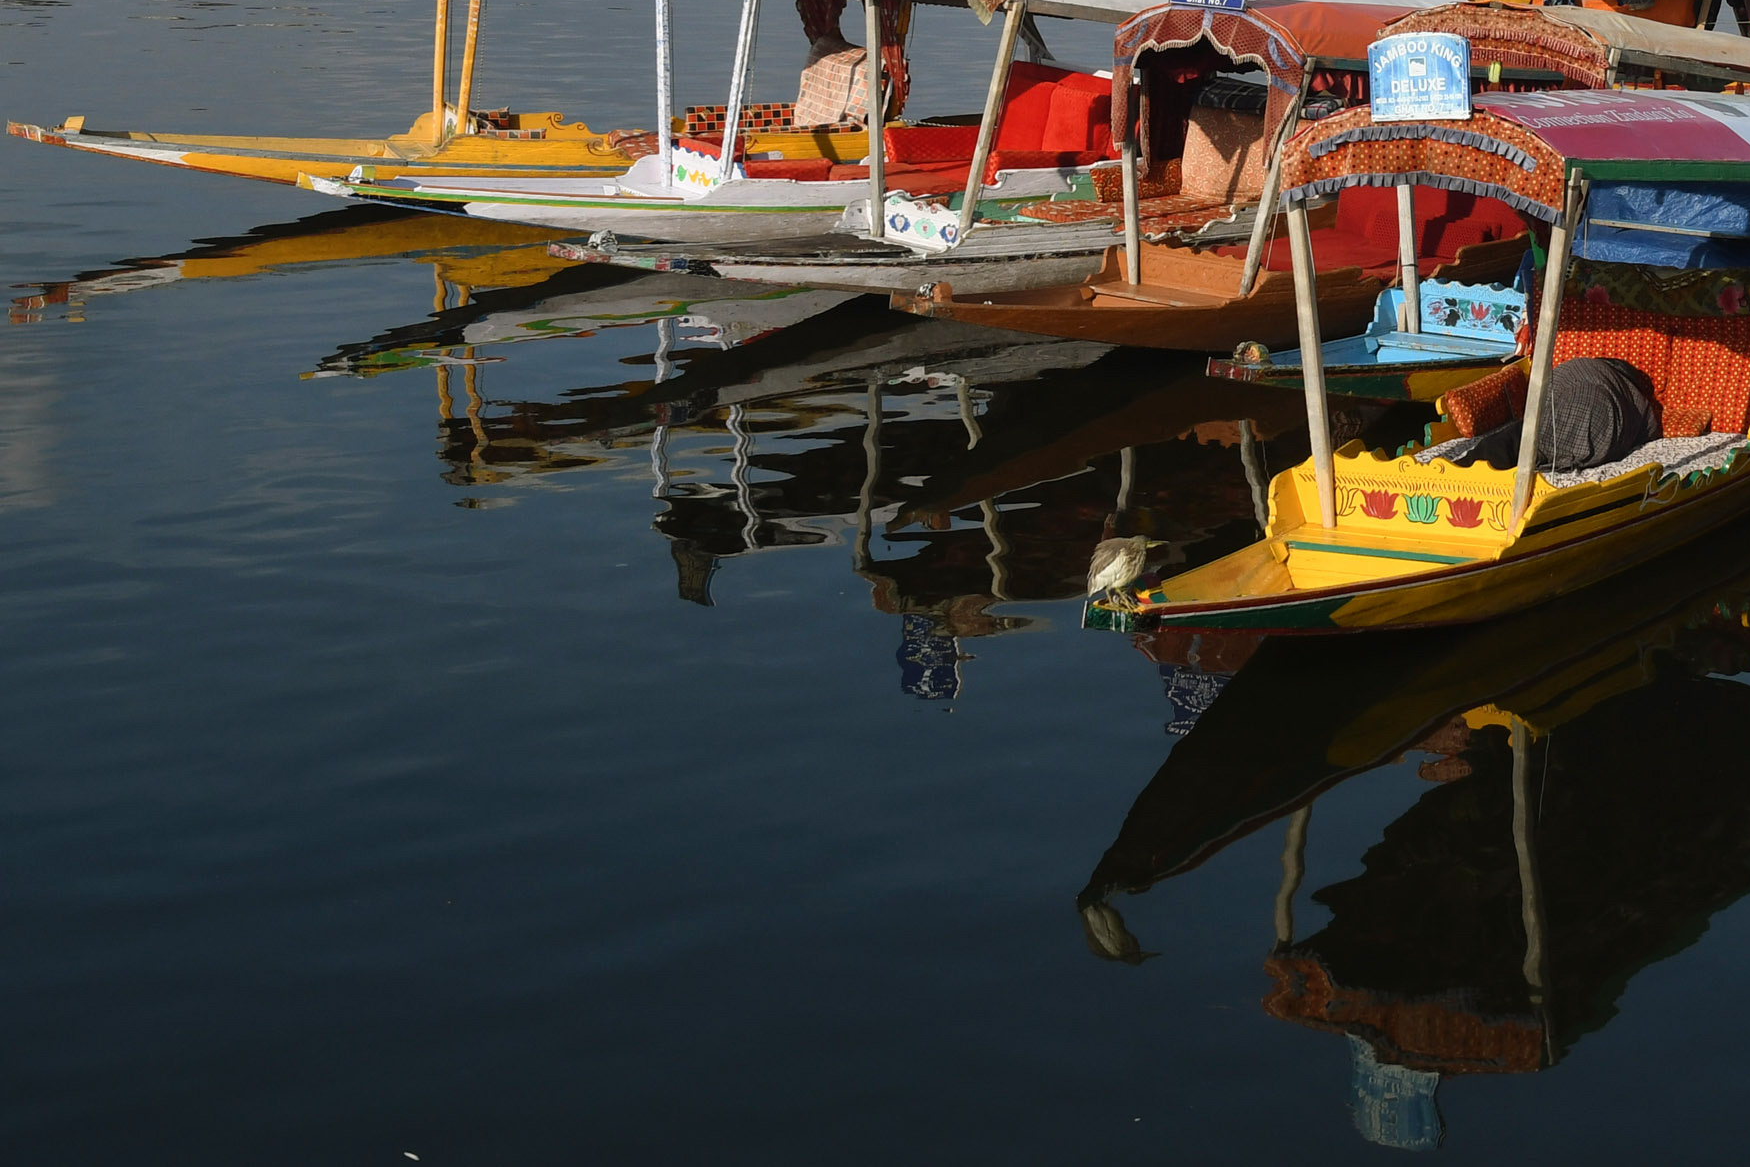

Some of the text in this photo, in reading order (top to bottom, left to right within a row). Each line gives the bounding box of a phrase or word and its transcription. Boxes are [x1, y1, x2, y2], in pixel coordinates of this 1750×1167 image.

[1374, 40, 1462, 74] JAMBOO KING
[1391, 77, 1446, 94] DELUXE
[1394, 104, 1419, 114] GHAT
